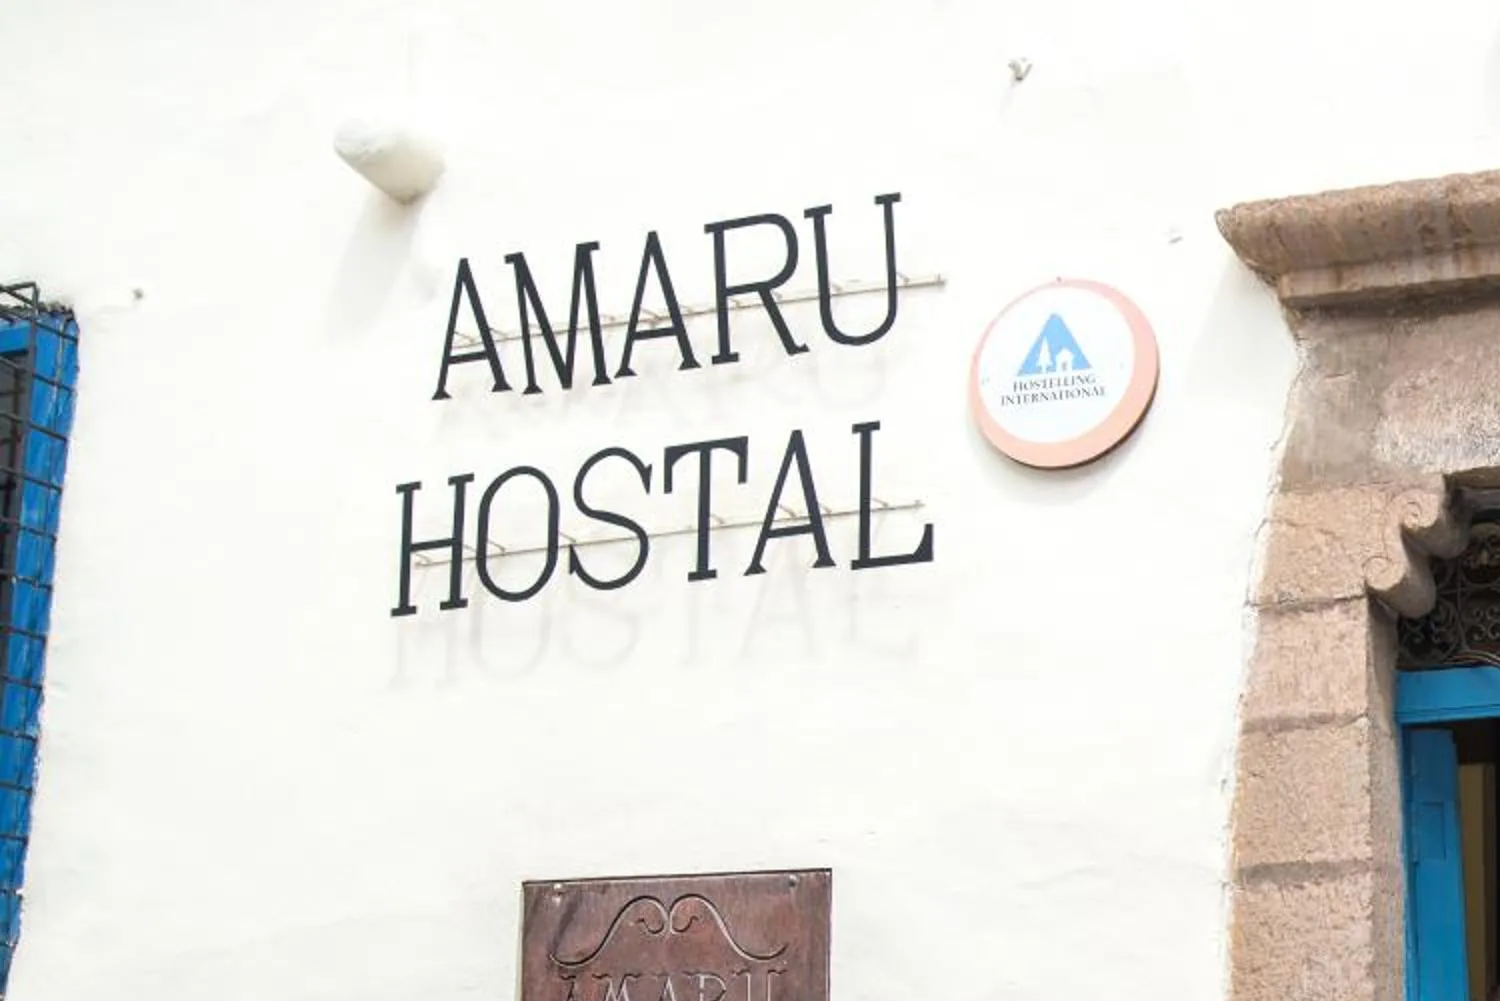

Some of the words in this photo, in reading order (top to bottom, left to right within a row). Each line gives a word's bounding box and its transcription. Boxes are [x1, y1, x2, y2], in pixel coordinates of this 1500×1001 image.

[431, 191, 902, 400] AMARU
[1000, 385, 1106, 407] INTERNATIONAL
[1012, 374, 1098, 393] HOSTELLING
[391, 420, 934, 617] HOSTAL
